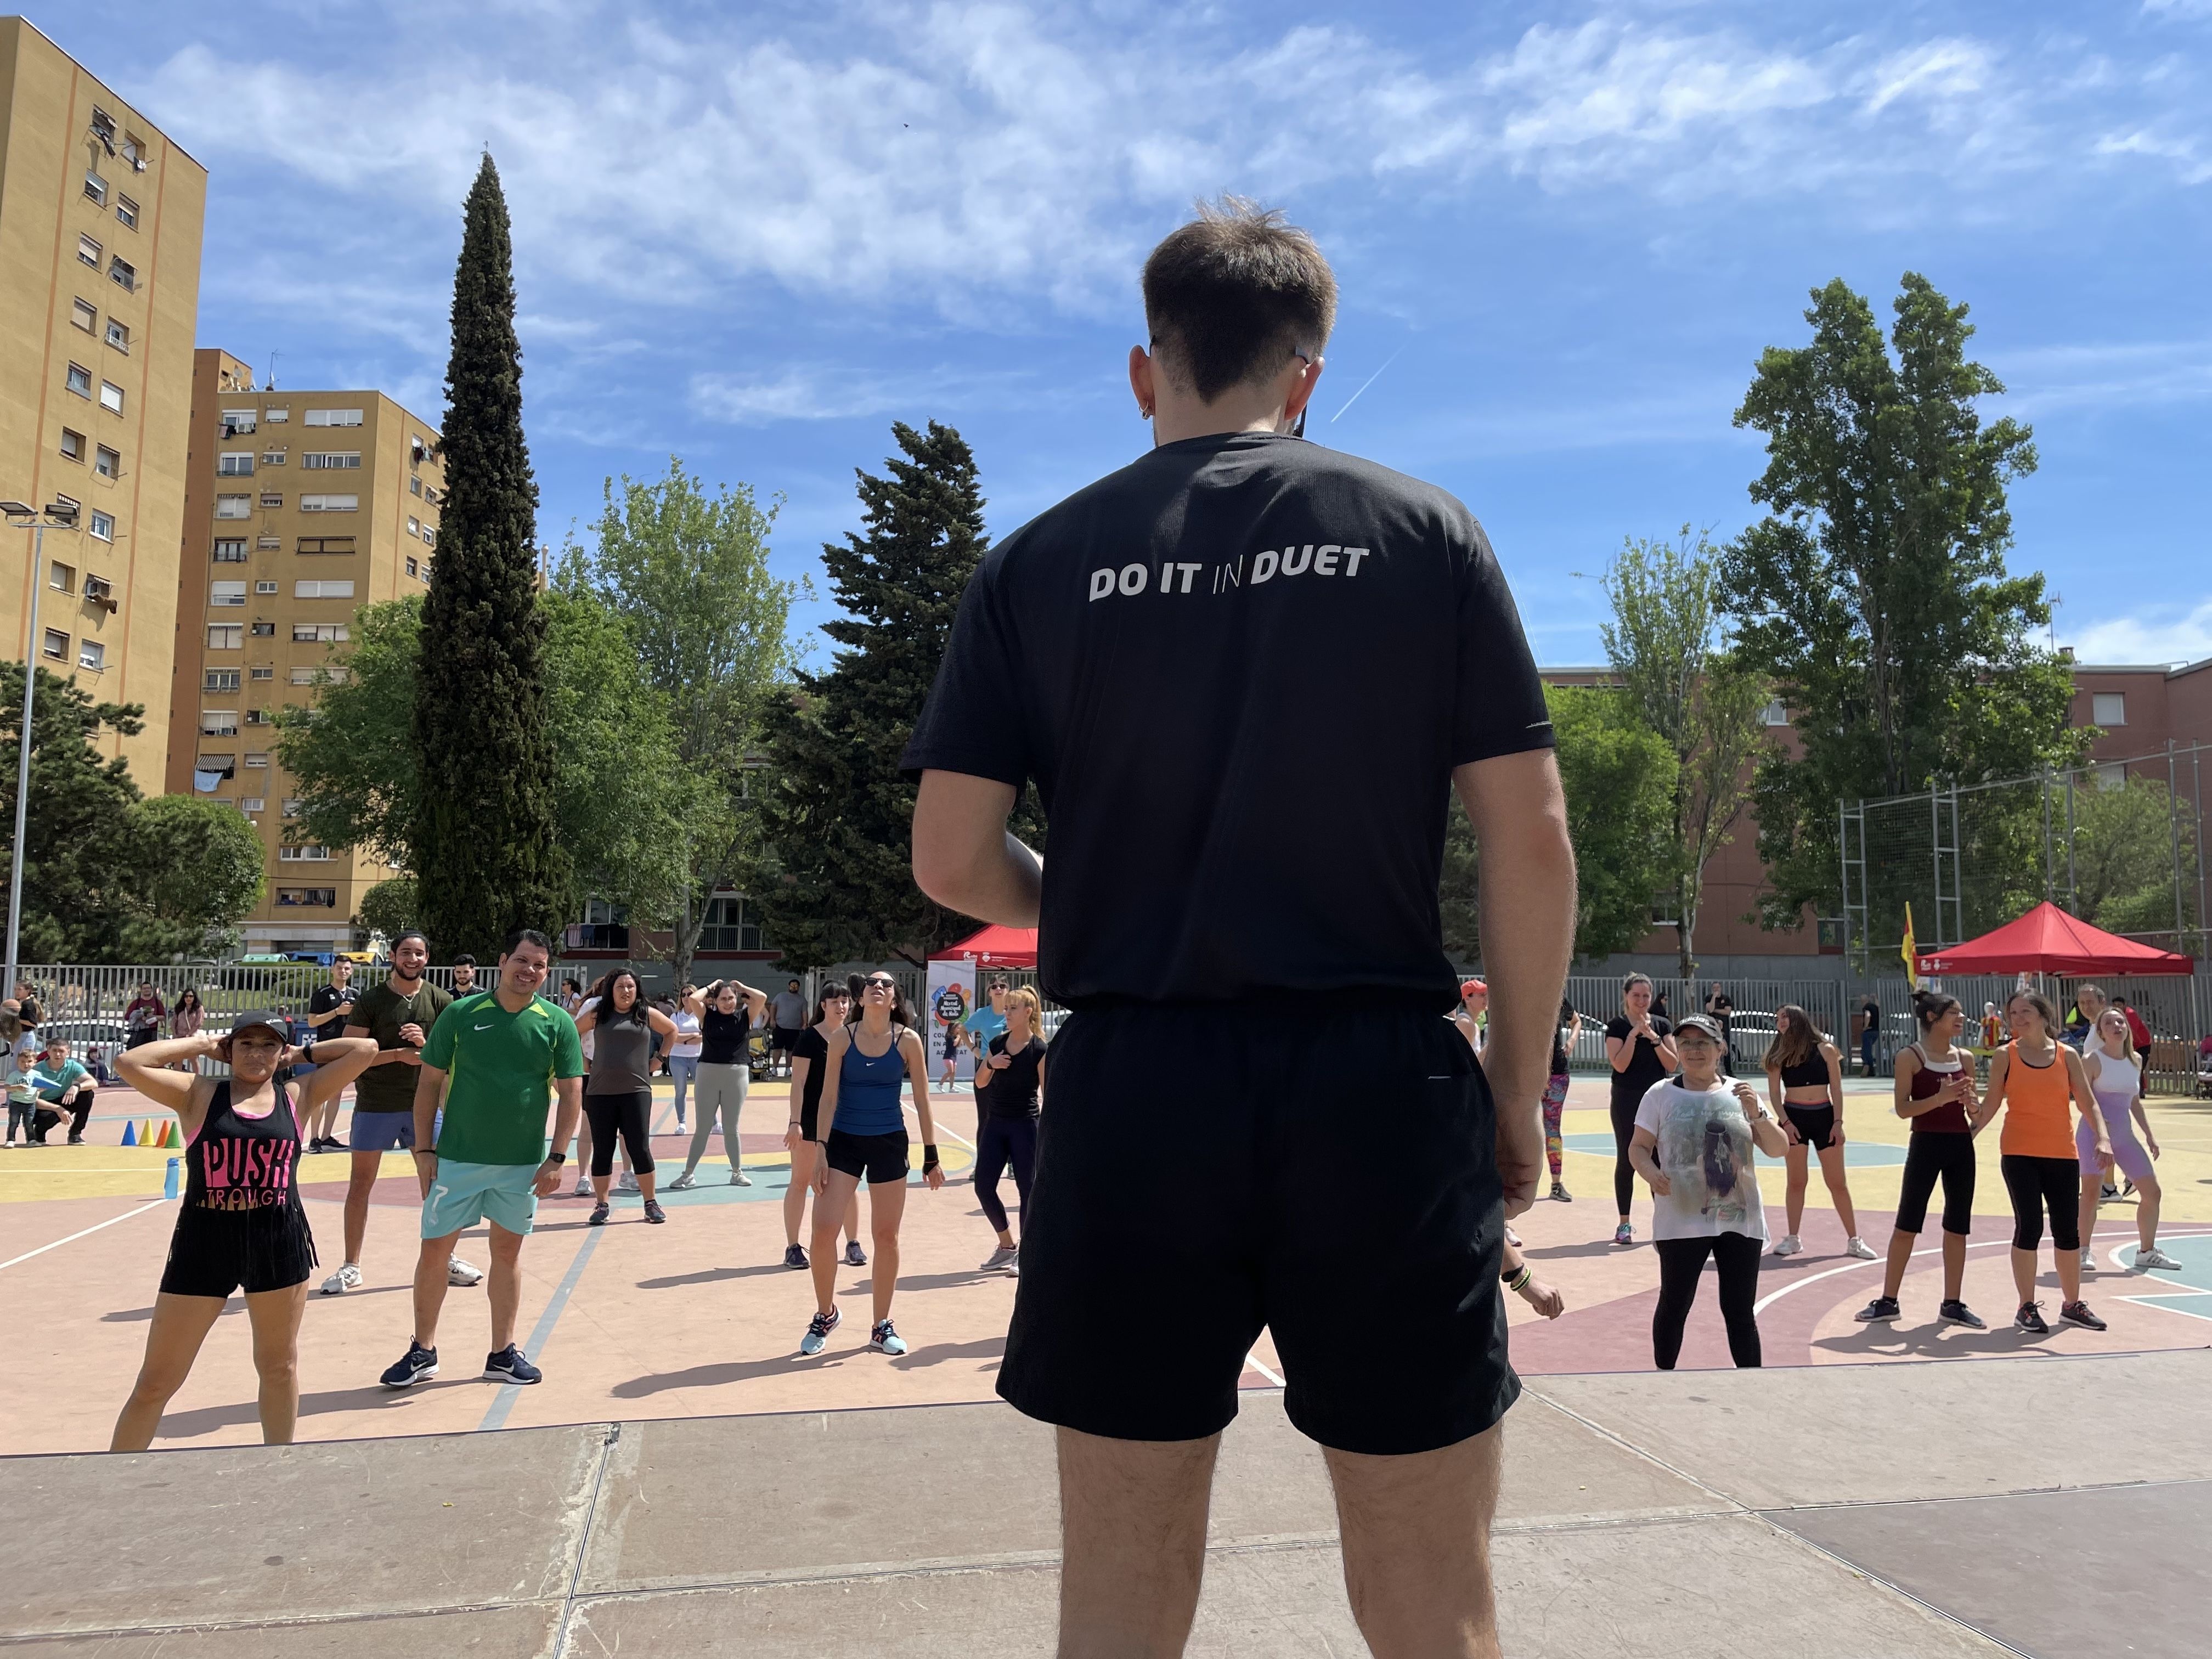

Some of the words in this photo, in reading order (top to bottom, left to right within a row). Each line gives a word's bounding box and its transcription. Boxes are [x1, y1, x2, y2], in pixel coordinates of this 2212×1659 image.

[1089, 563, 1148, 602] DO
[1160, 562, 1202, 593] IT
[1213, 554, 1243, 594] IN
[1251, 544, 1370, 584] DUET
[1679, 1015, 1710, 1026] adidas
[203, 1138, 295, 1189] PUSH
[206, 1188, 287, 1206] TROUGH
[431, 1184, 449, 1212] 7
